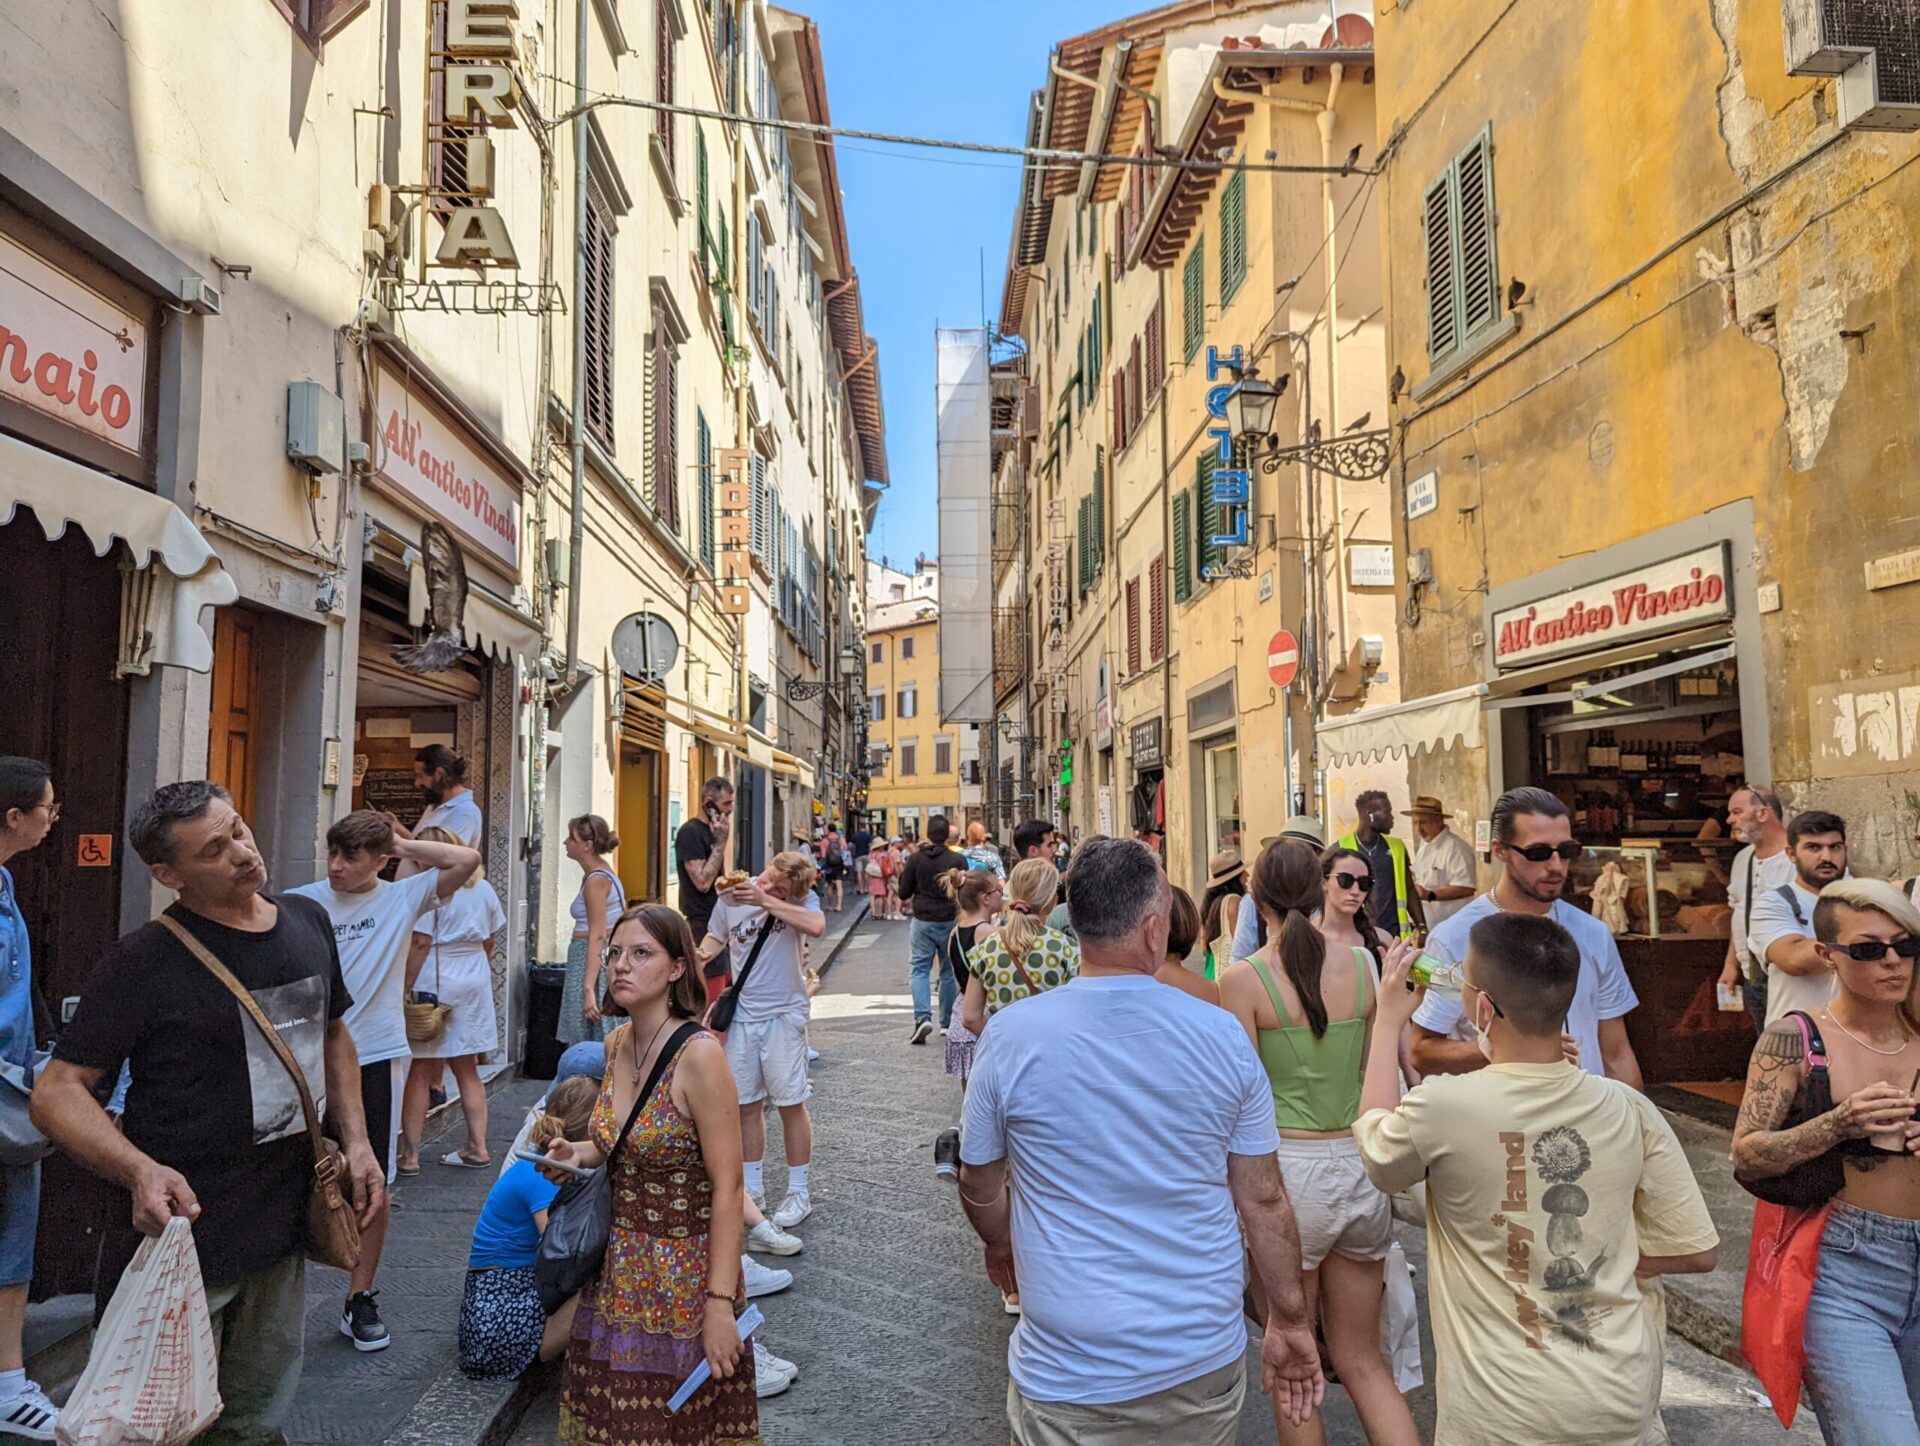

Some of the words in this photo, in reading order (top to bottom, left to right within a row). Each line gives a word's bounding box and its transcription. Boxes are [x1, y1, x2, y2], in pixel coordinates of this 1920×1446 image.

[386, 410, 471, 510] All'antico
[472, 478, 516, 546] Vinaio
[721, 449, 750, 614] FORNO
[1497, 600, 1613, 657] All'antico
[1612, 567, 1723, 626] Vinaio
[1499, 1132, 1527, 1212] land
